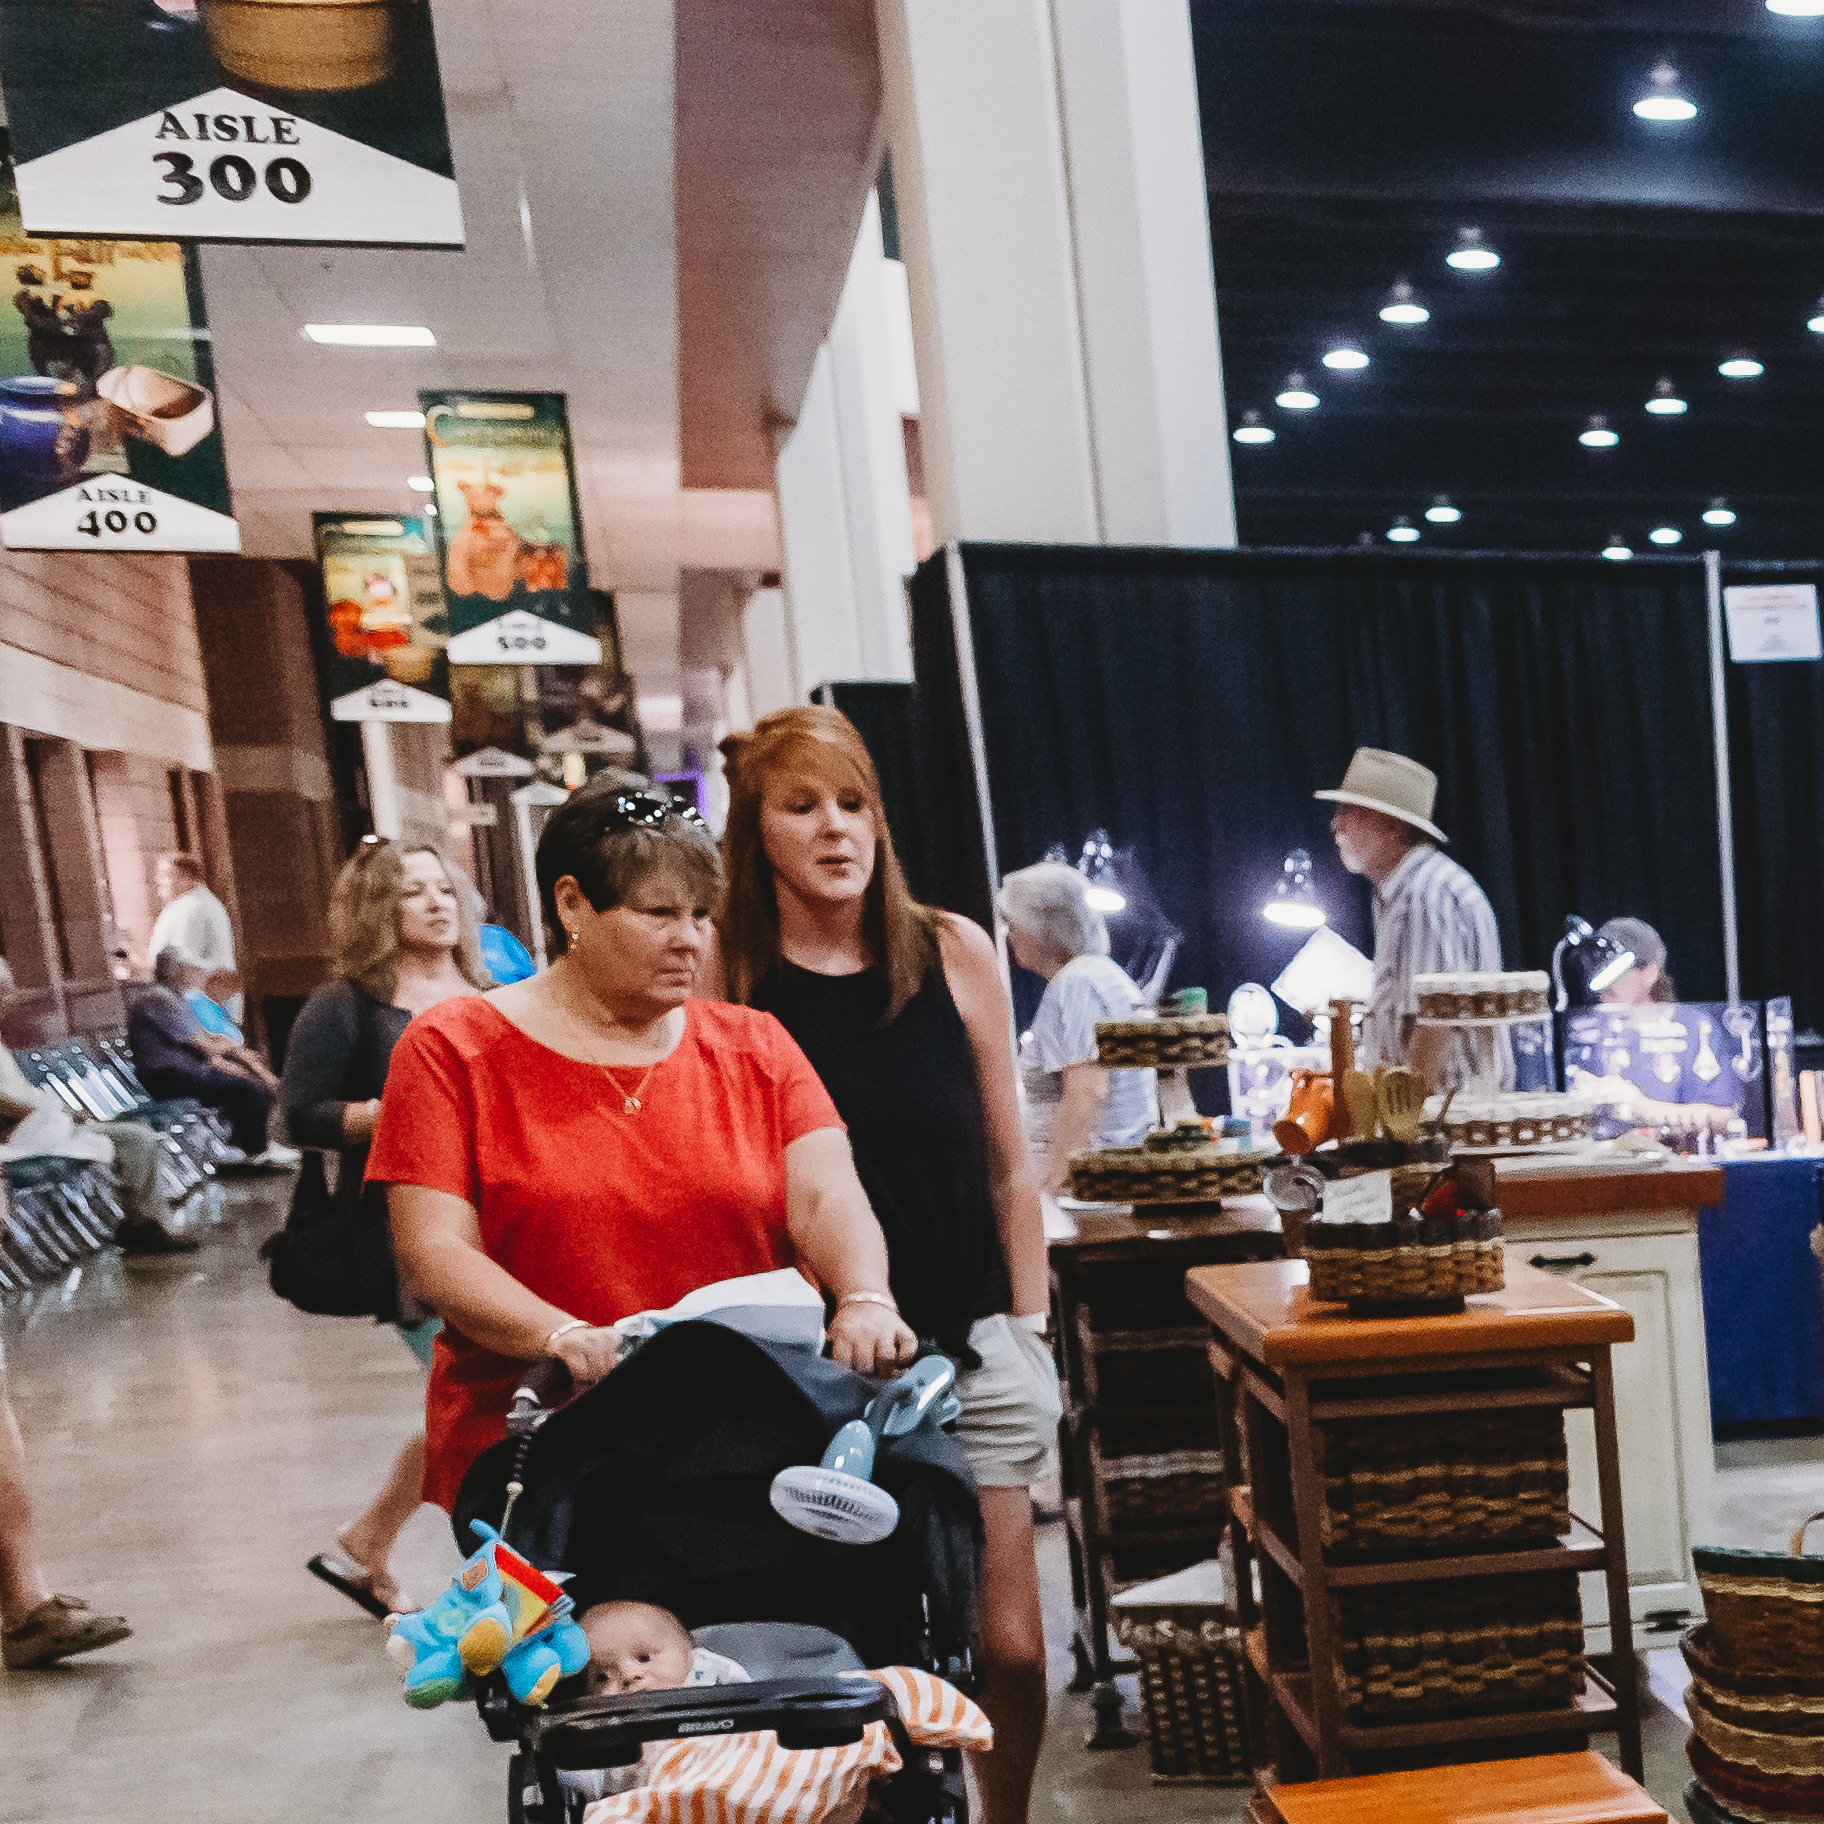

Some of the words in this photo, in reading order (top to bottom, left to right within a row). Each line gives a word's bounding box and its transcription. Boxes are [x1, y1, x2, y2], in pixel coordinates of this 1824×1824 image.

[154, 110, 301, 145] AISLE
[152, 151, 313, 206] 300
[76, 488, 153, 505] AISLE
[77, 509, 158, 538] 400
